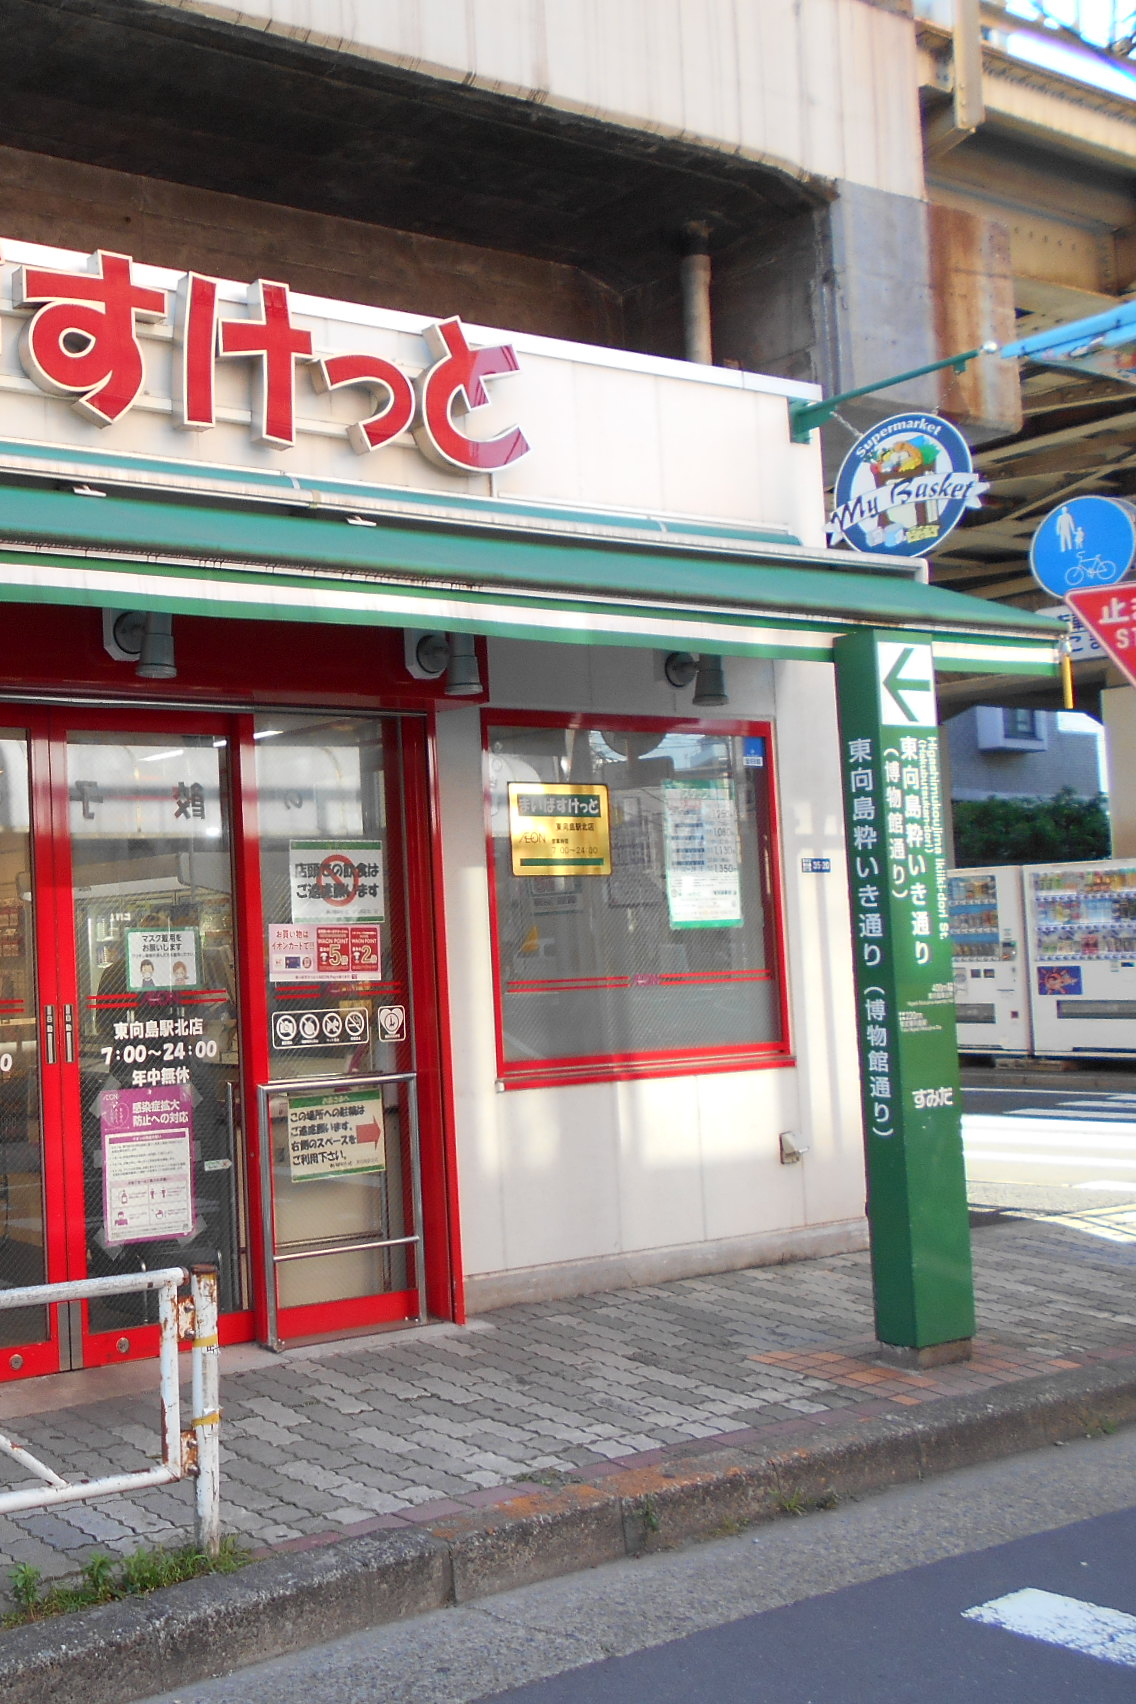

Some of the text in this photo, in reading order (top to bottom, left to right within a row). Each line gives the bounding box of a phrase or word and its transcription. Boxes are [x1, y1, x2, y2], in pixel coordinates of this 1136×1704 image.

[856, 417, 943, 458] Supermarket
[830, 472, 975, 532] My Basket
[1098, 597, 1136, 624] 止
[520, 797, 599, 814] まいばすけっと
[899, 736, 930, 965] 東向島粋いき通り
[114, 1018, 203, 1040] 東向島駅北店
[132, 1066, 190, 1088] 年中無休
[133, 1111, 189, 1127] 防止への対応
[291, 1134, 357, 1152] 右側のスペースを
